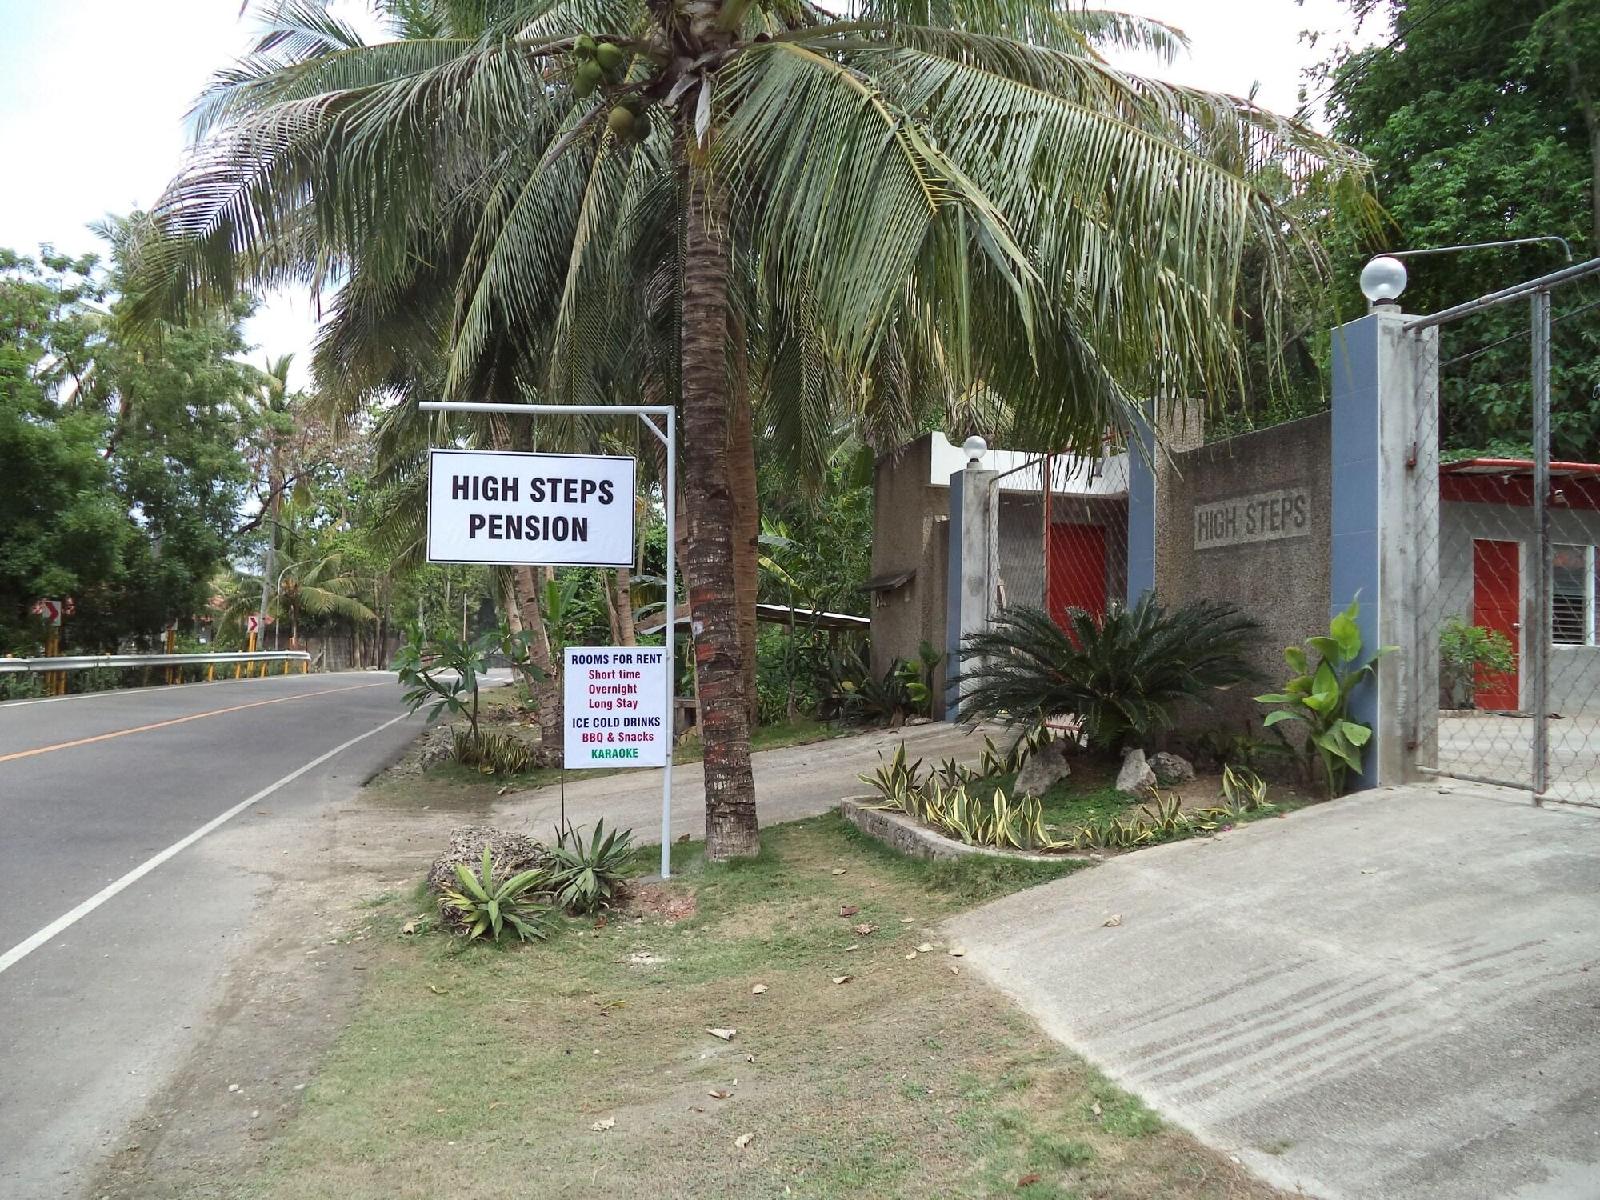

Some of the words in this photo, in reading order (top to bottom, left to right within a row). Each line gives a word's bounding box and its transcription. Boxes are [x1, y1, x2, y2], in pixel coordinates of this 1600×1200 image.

[452, 475, 519, 502] HIGH
[529, 477, 614, 505] STEPS
[1198, 506, 1237, 541] HIGH
[1245, 494, 1306, 535] STEPS
[469, 514, 588, 541] PENSION
[571, 654, 609, 665] ROOMS
[613, 654, 632, 664] FOR
[636, 653, 662, 664] RENT
[588, 669, 615, 679] Short
[619, 669, 641, 679] time
[589, 684, 637, 695] Overnight
[589, 699, 612, 710] Long
[616, 698, 638, 710] Stay
[572, 718, 589, 728] ICE
[593, 717, 620, 728] COLD
[623, 716, 661, 727] DRINKS
[582, 732, 603, 743] BBQ
[607, 732, 615, 742] &
[618, 731, 654, 742] Snacks
[591, 748, 639, 759] KARAOKE
